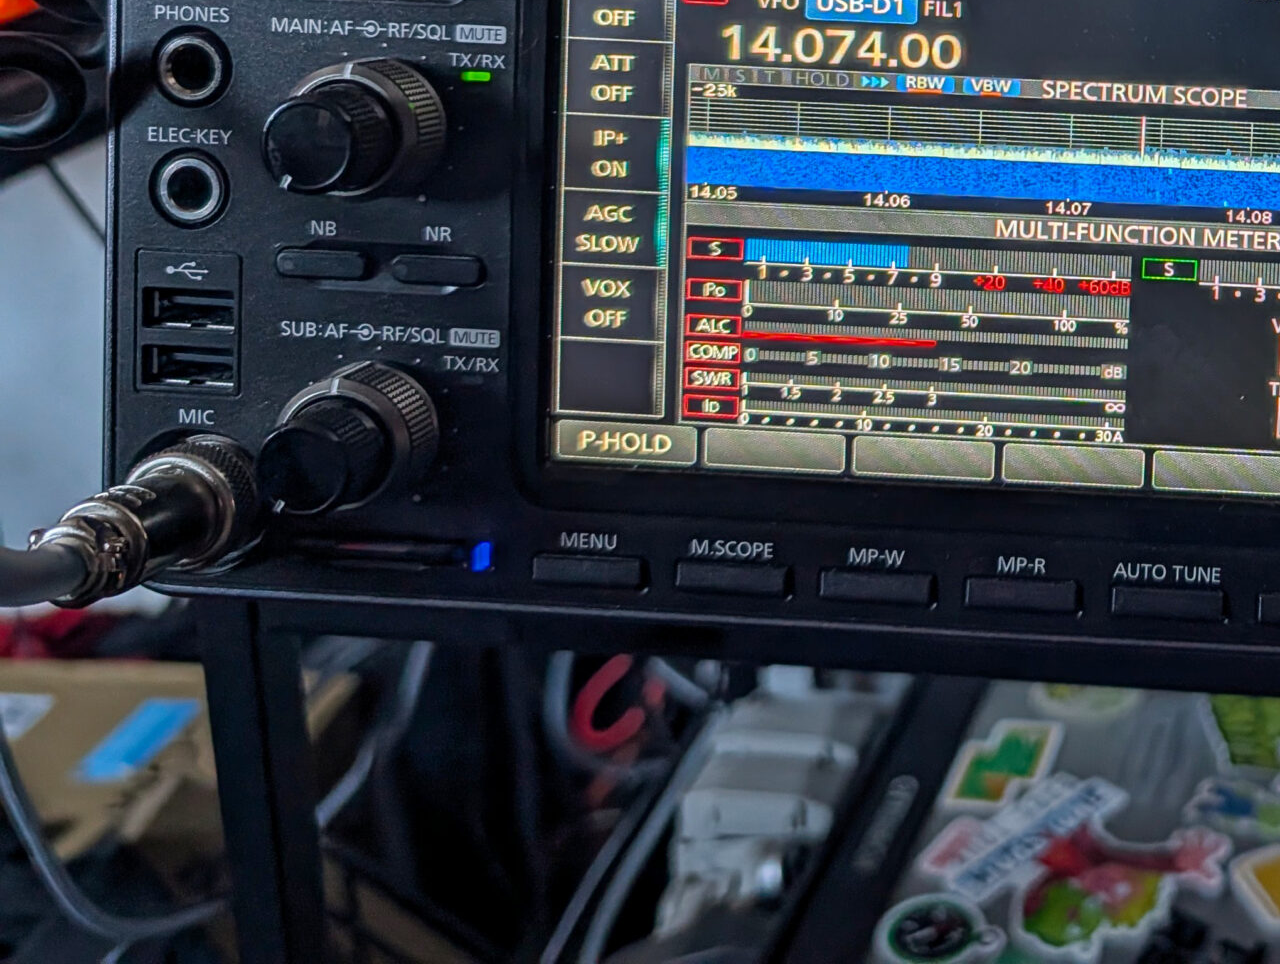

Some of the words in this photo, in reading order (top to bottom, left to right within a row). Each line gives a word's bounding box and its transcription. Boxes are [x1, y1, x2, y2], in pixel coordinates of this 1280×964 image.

[155, 5, 230, 23] PHONES
[593, 9, 636, 27] OFF
[924, 0, 962, 18] FIL1
[388, 23, 451, 41] RF/SQL
[459, 27, 503, 42] MUTE
[722, 24, 962, 70] 14.074.00
[449, 52, 505, 69] TX/RX
[590, 54, 636, 71] ATT
[590, 84, 634, 102] OFF
[1042, 80, 1166, 104] SPECTRUM
[1173, 86, 1248, 108] SCOPE
[147, 126, 232, 146] ELEC-KEY
[591, 160, 629, 177] ON
[583, 204, 635, 223] AGC
[1045, 201, 1092, 216] 14.07
[1226, 209, 1272, 224] 14.08
[311, 220, 337, 236] NB
[425, 226, 452, 242] NR
[995, 219, 1195, 246] MULTI-FUNCTION
[1203, 228, 1280, 250] METER
[575, 234, 640, 253] SLOW
[581, 278, 632, 298] VOX
[583, 309, 628, 328] OFF
[382, 325, 445, 344] RF/SQL
[453, 330, 497, 346] MUTE
[689, 344, 738, 360] COMP
[443, 355, 500, 373] TX/RX
[691, 370, 731, 386] SWR
[179, 409, 215, 425] MIC
[577, 430, 673, 455] P-HOLD
[560, 532, 618, 550] MENU
[690, 538, 774, 559] M.SCOPE
[848, 547, 905, 566] MP-W
[997, 555, 1046, 573] MP-R
[1113, 562, 1166, 581] AUTO
[1172, 565, 1221, 584] TUNE
